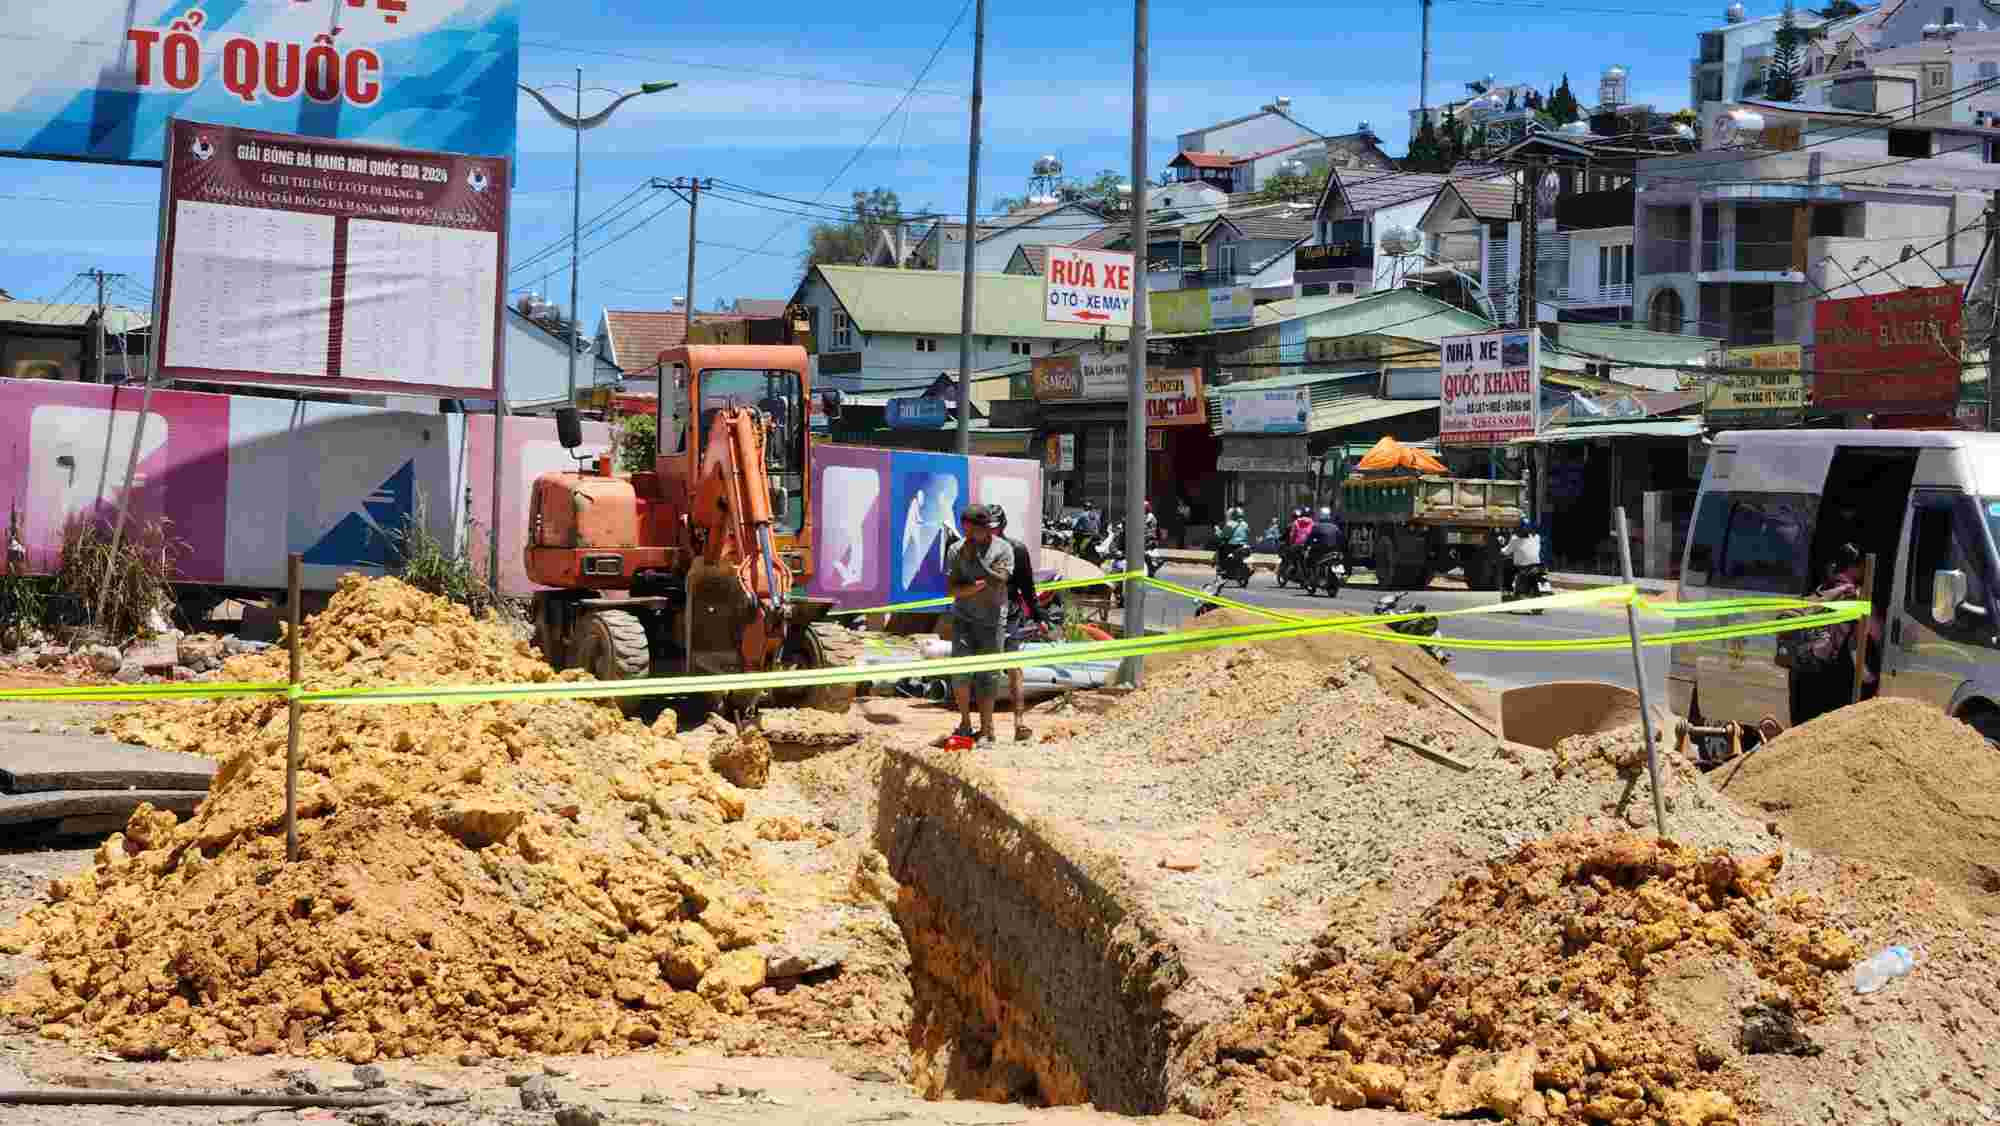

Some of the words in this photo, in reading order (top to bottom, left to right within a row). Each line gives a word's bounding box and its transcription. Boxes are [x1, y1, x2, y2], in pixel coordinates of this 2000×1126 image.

[127, 10, 204, 89] TỔ
[223, 26, 379, 104] QUỐC
[237, 141, 261, 161] GIẢI
[263, 145, 294, 165] BÓNG
[295, 149, 313, 168] ĐÁ
[315, 154, 345, 173] HẠNG
[369, 158, 400, 177] QUỐC
[401, 164, 420, 181] GIA
[1051, 252, 1096, 288] RỬA
[1103, 263, 1131, 290] XE
[1087, 295, 1102, 309] XE
[1479, 340, 1498, 361] XE
[1444, 366, 1480, 402] QUỐC
